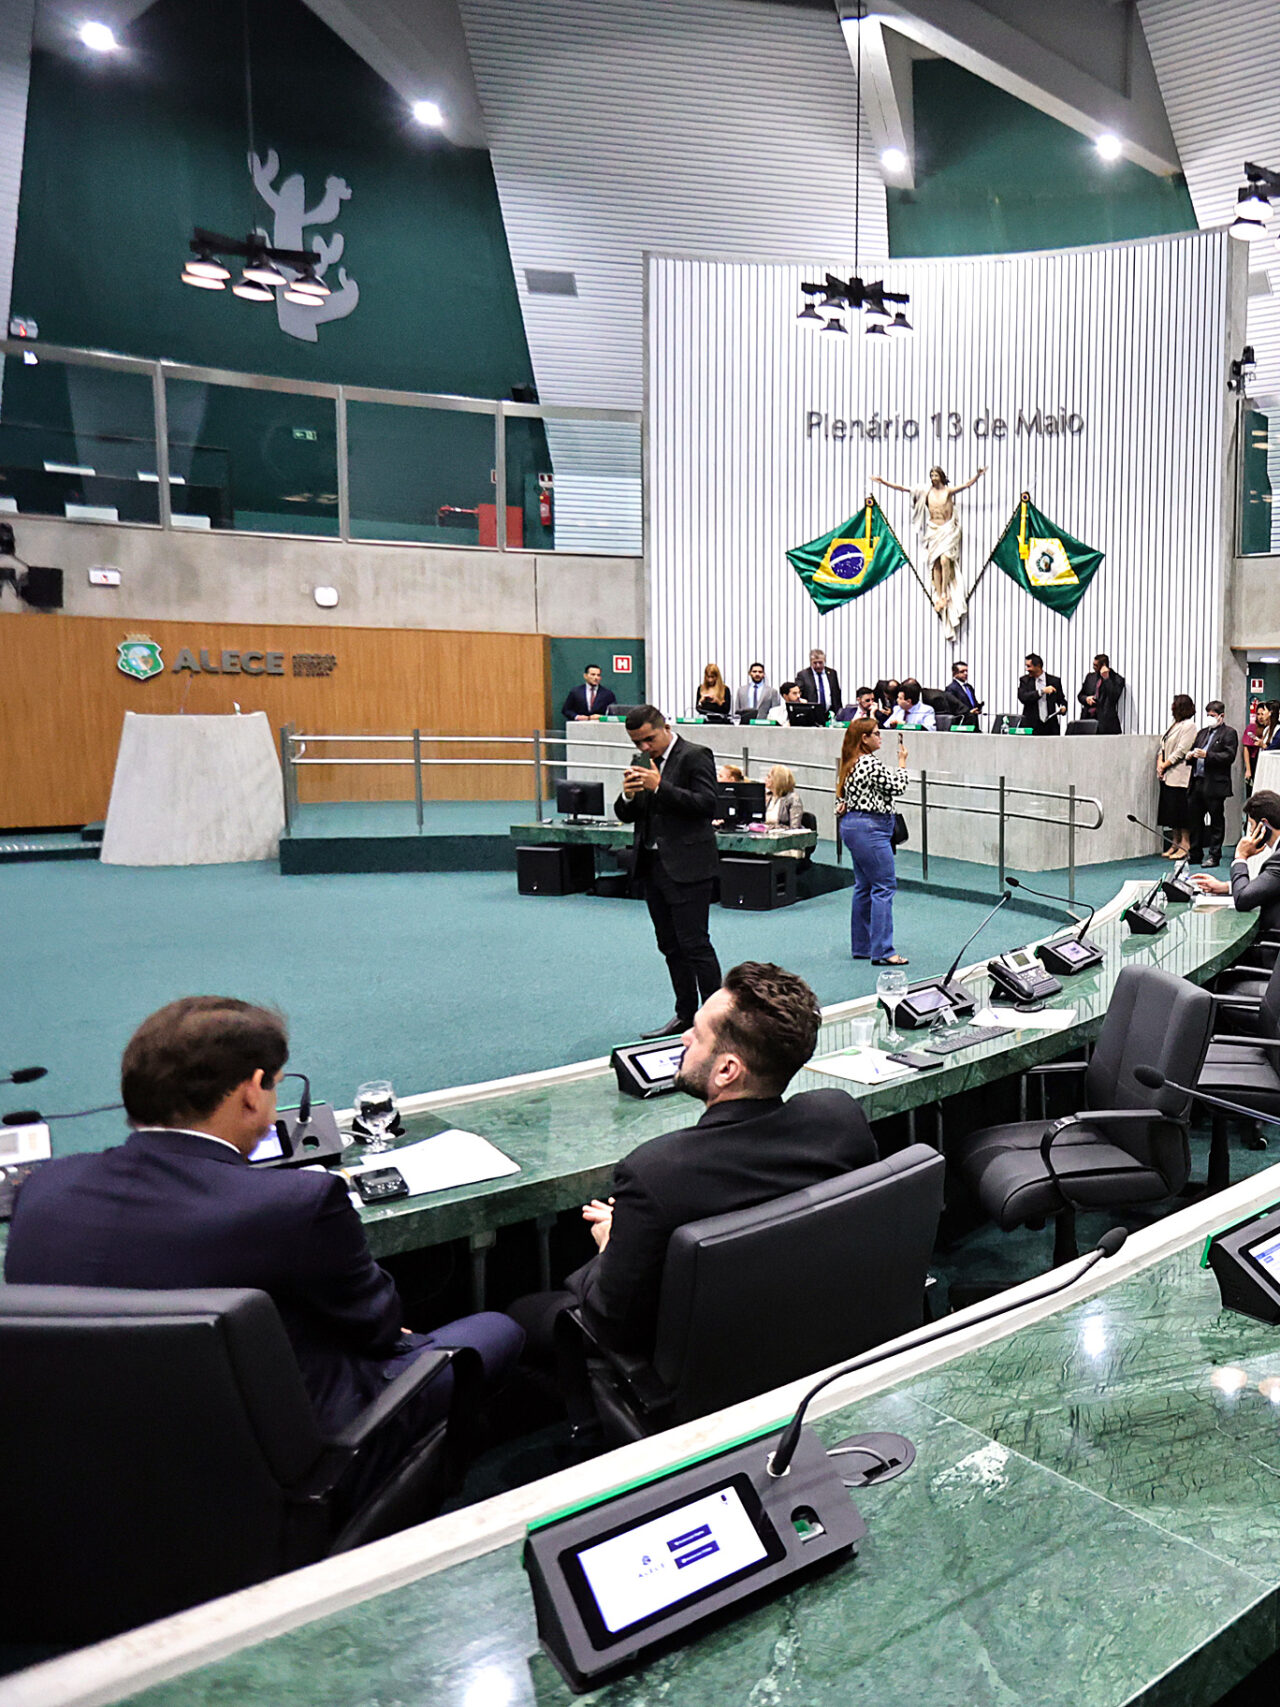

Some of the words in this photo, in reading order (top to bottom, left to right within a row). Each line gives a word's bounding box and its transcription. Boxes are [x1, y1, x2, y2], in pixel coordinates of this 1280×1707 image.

[806, 411, 920, 441] Plenário
[931, 411, 963, 441] 13
[973, 407, 1007, 438] de
[1016, 406, 1085, 438] Maio
[172, 648, 285, 676] ALECE
